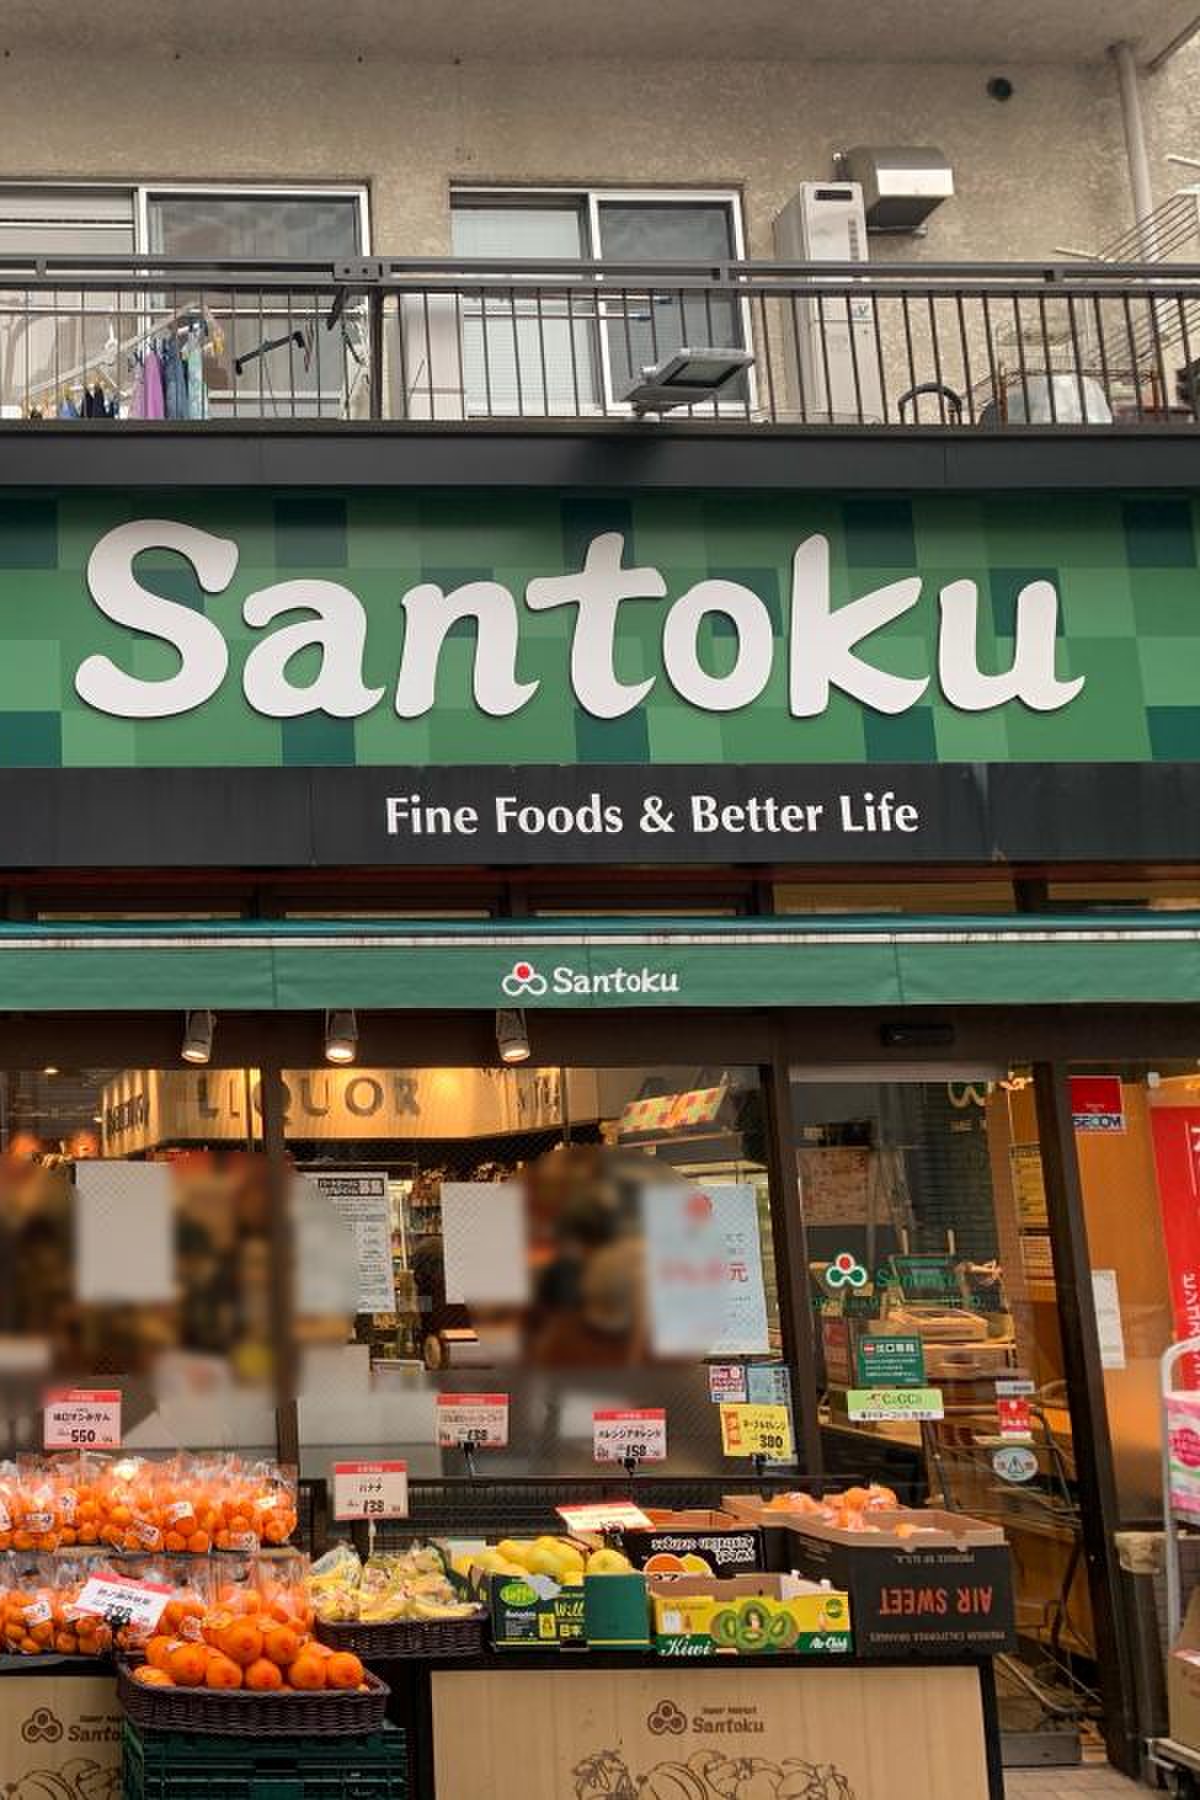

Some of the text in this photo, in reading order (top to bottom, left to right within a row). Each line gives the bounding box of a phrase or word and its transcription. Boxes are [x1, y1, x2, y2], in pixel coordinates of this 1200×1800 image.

[75, 519, 1086, 718] Santoku
[385, 791, 919, 835] Fine Foods & Better Life
[552, 967, 680, 994] Santoku
[1072, 1115, 1121, 1128] SECOM
[71, 1429, 96, 1443] 550
[759, 1434, 784, 1449] 380
[625, 1444, 647, 1457] 158
[879, 1586, 993, 1615] AIR SWEET
[660, 1634, 713, 1657] Kiwi
[67, 1725, 121, 1742] Santo
[691, 1717, 764, 1733] Santoku
